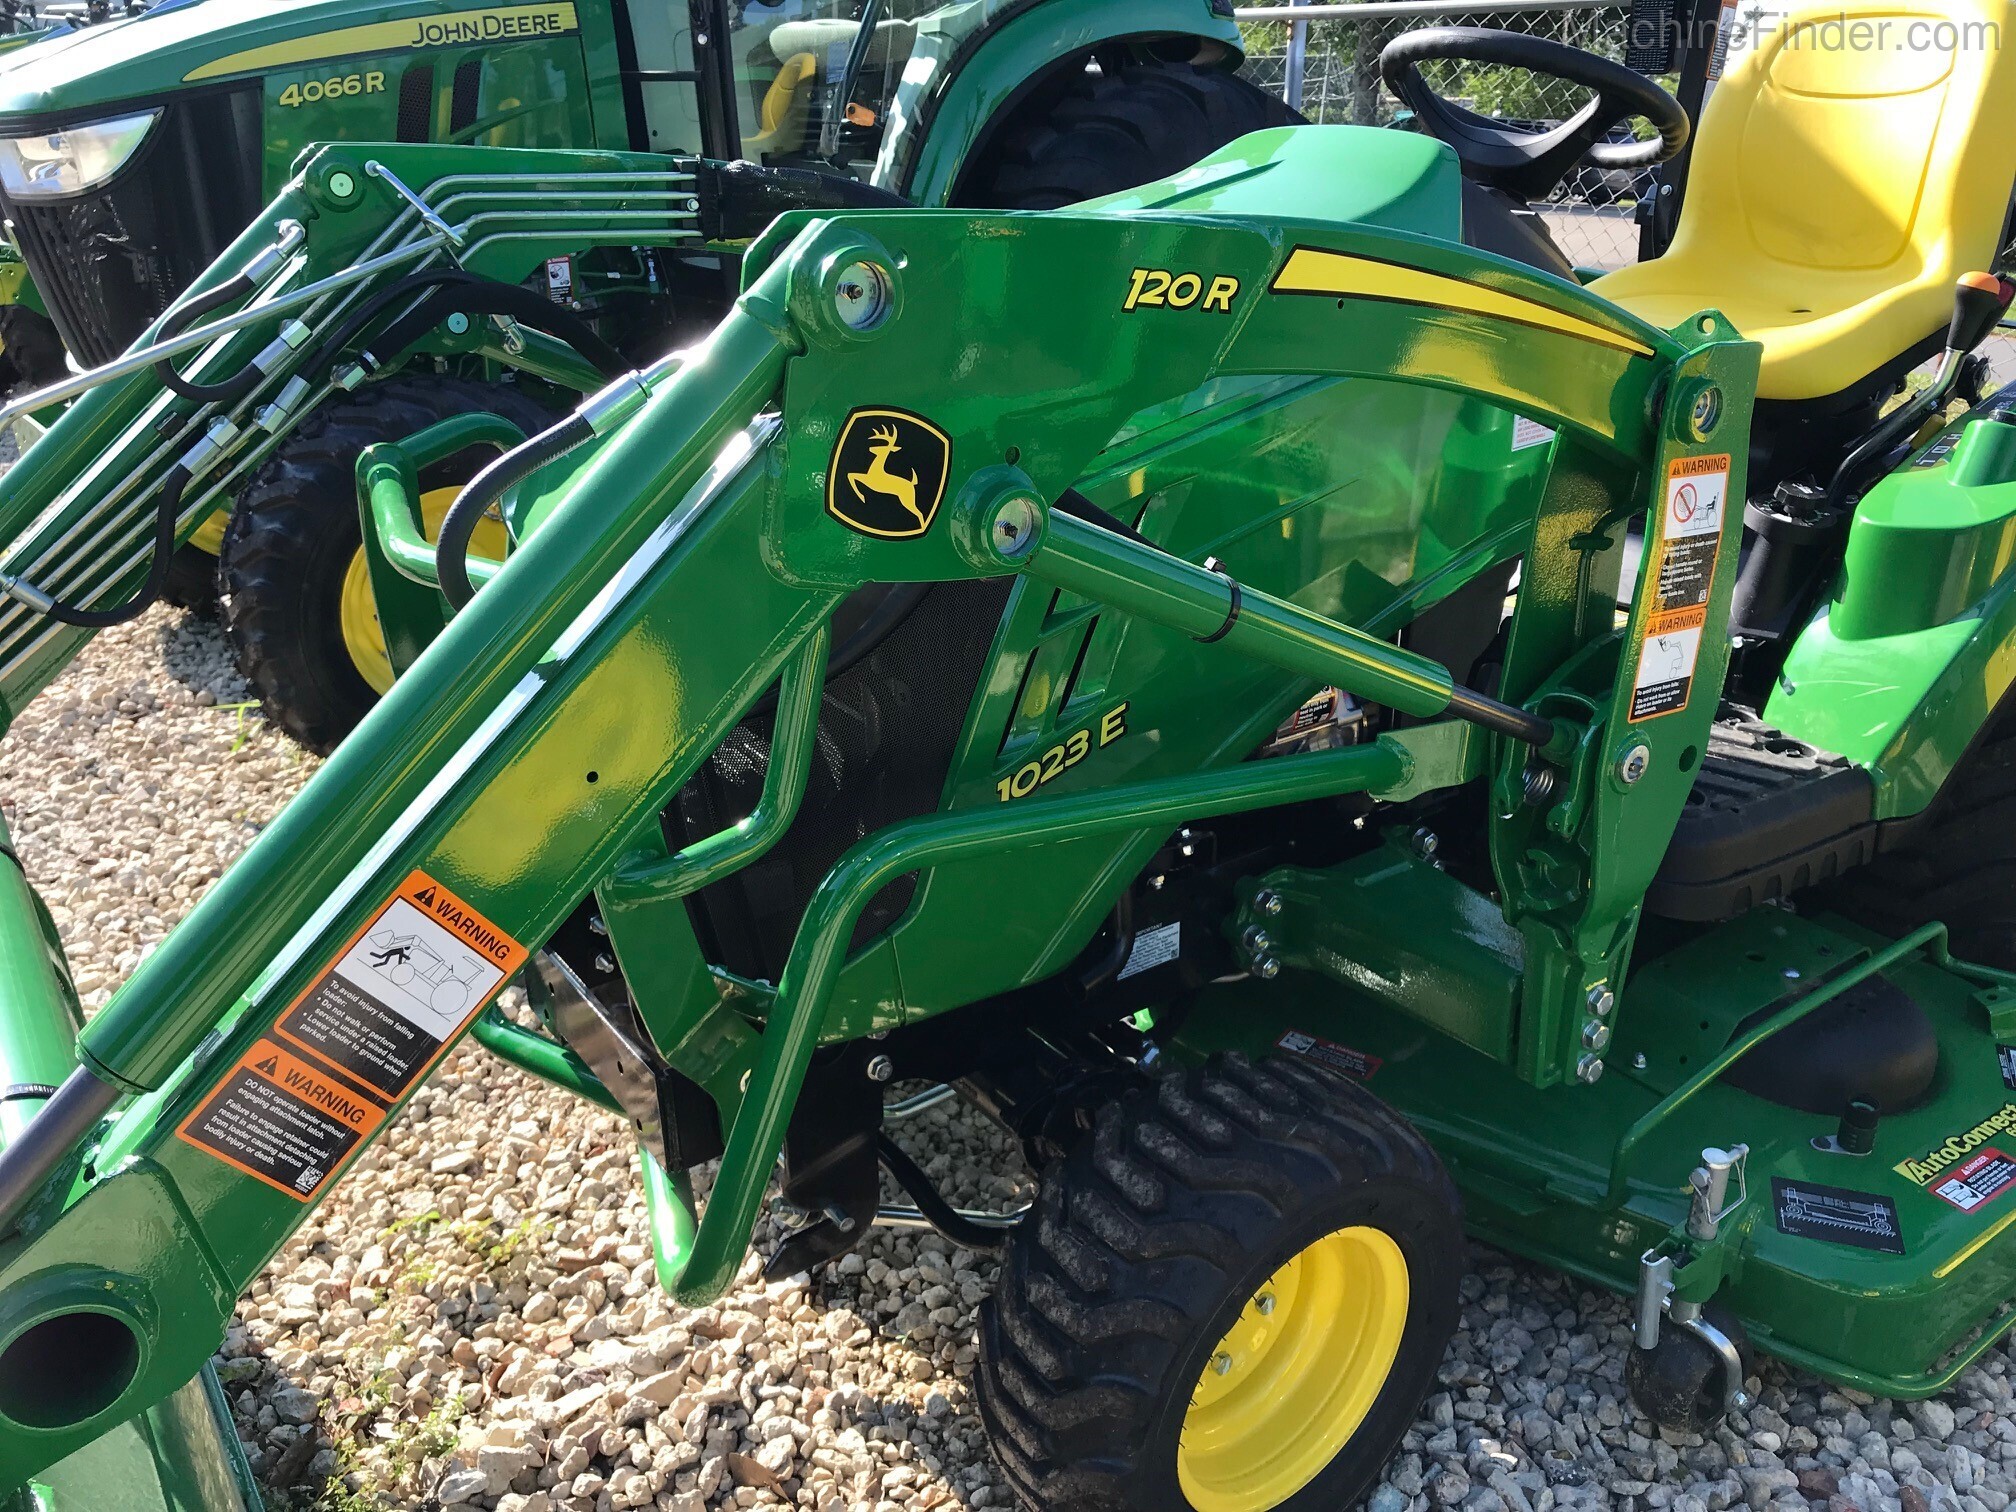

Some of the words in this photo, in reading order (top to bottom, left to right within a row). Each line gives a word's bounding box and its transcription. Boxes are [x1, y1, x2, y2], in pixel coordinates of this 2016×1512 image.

[412, 20, 479, 44] JOHN
[482, 13, 562, 36] DEERE
[279, 74, 362, 107] 4066
[365, 71, 385, 93] R
[1123, 268, 1202, 311] 120
[1202, 275, 1239, 311] R
[1682, 456, 1727, 474] WARNING
[1659, 612, 1702, 632] WARNING
[997, 729, 1089, 801] 1023
[1100, 702, 1127, 747] E
[436, 898, 510, 960] WARNING
[323, 988, 347, 1007] loader:
[330, 980, 339, 990] To
[339, 988, 359, 1003] avoid
[358, 999, 378, 1015] injury
[378, 1012, 394, 1025] from
[394, 1022, 415, 1040] falling
[299, 1023, 326, 1042] parked.
[307, 1014, 330, 1032] Lower
[329, 1028, 353, 1046] loader
[352, 1042, 360, 1050] to
[359, 1048, 385, 1066] ground
[384, 1064, 402, 1077] when
[315, 1008, 340, 1027] service
[340, 1024, 360, 1039] under
[366, 1040, 388, 1056] raised
[321, 999, 332, 1009] Do
[332, 1007, 345, 1018] not
[345, 1014, 361, 1028] walk
[361, 1025, 370, 1034] or
[368, 1030, 396, 1050] perform
[238, 1087, 270, 1109] engaging
[270, 1105, 307, 1132] attachment
[307, 1125, 325, 1140] latch.
[245, 1078, 258, 1089] DO
[257, 1085, 275, 1098] NOT
[274, 1094, 300, 1113] operate
[299, 1108, 322, 1125] loader
[320, 1122, 346, 1140] without
[284, 1068, 366, 1124] WARNING
[204, 1123, 227, 1140] bodily
[226, 1134, 246, 1151] injury
[246, 1145, 254, 1154] or
[254, 1150, 275, 1165] death.
[211, 1115, 228, 1128] from
[228, 1125, 251, 1140] loader
[250, 1137, 279, 1156] causing
[278, 1151, 303, 1168] serious
[219, 1108, 239, 1122] result
[239, 1117, 246, 1126] in
[246, 1120, 286, 1148] attachment
[285, 1143, 318, 1166] detaching
[226, 1099, 250, 1116] Failure
[250, 1112, 258, 1120] to
[258, 1117, 284, 1134] engage
[284, 1131, 310, 1149] retainer
[309, 1144, 329, 1159] could
[1907, 1103, 2016, 1182] AutoConnect
